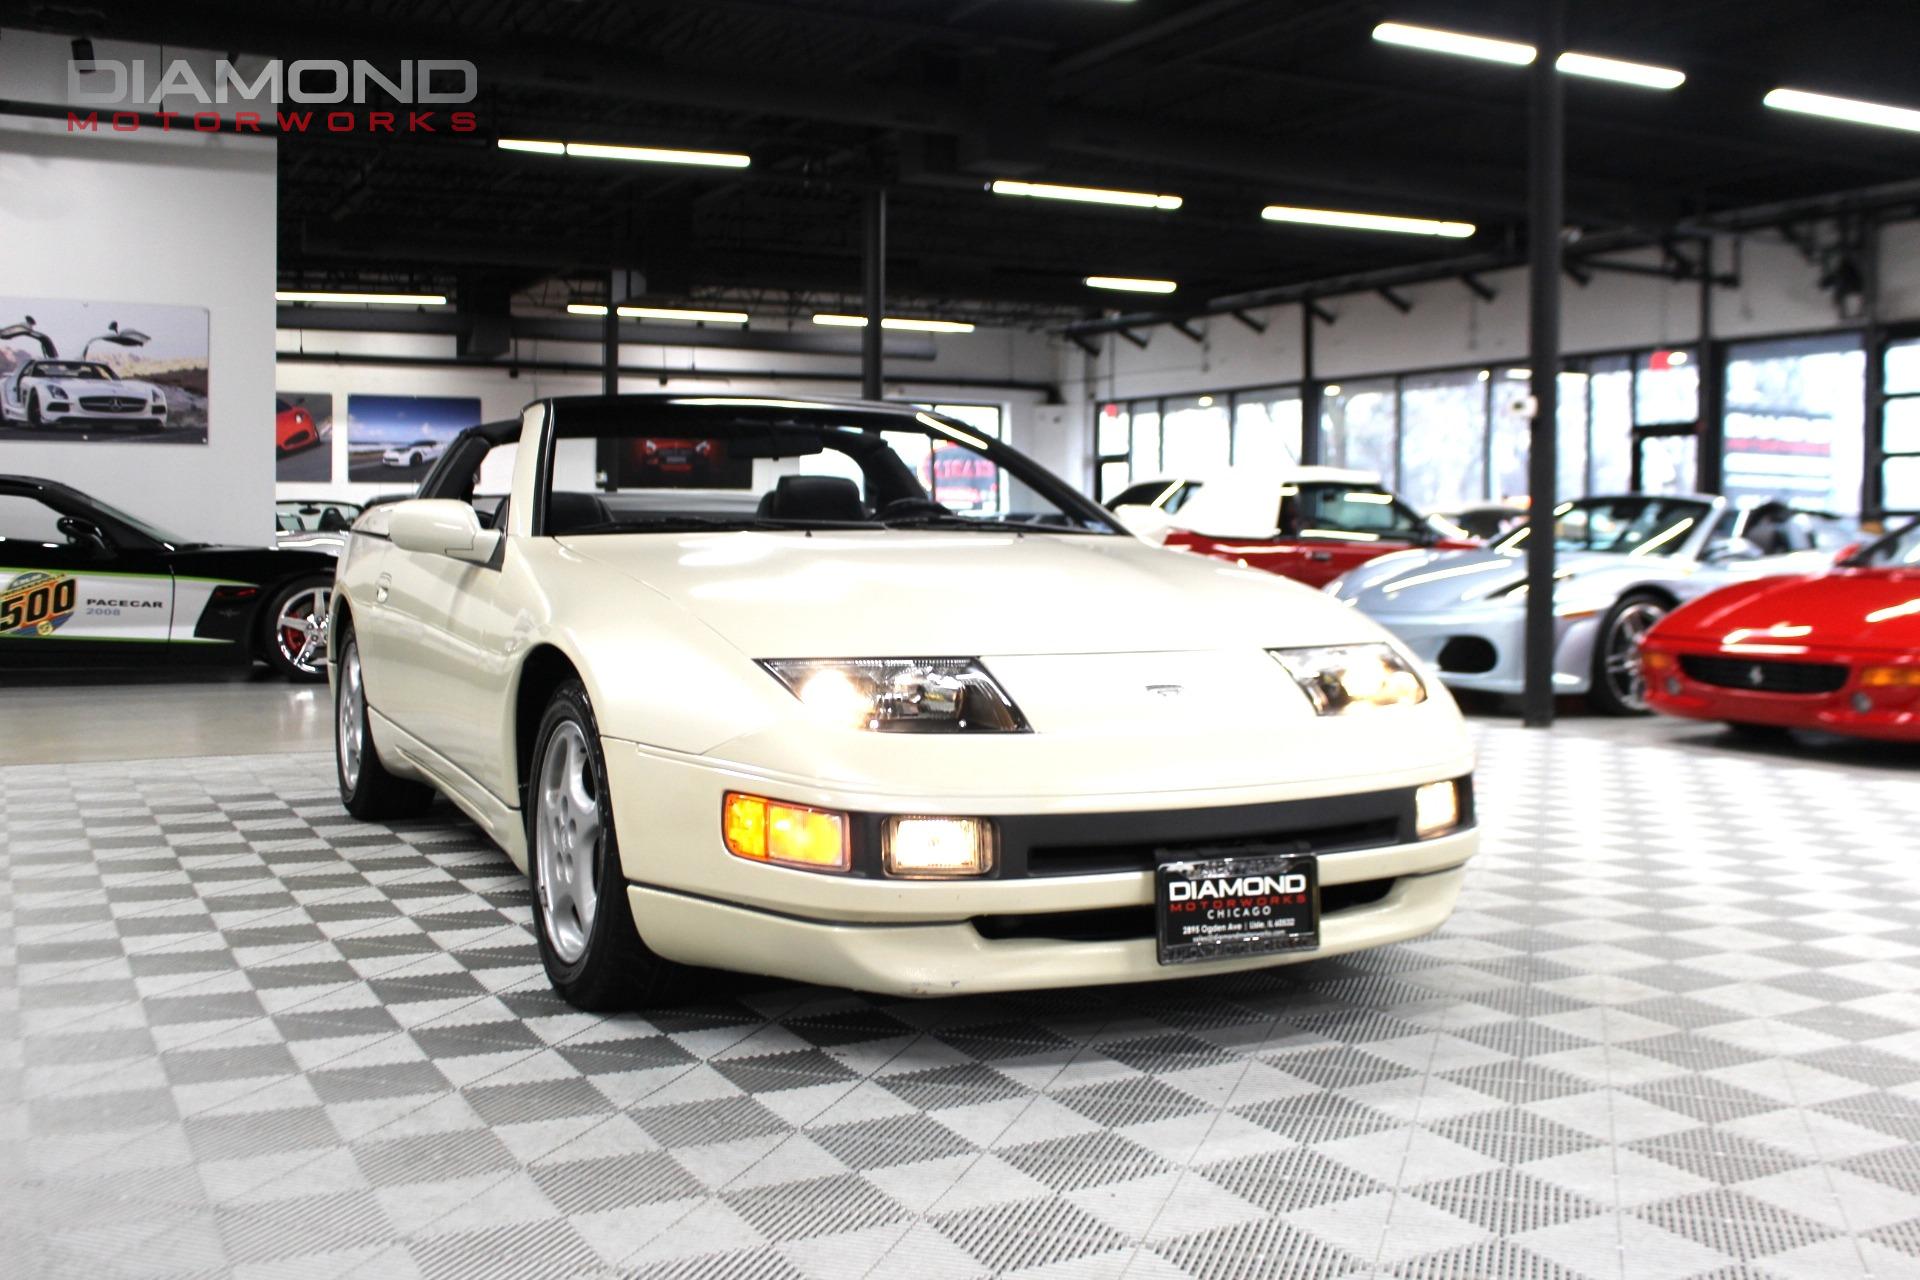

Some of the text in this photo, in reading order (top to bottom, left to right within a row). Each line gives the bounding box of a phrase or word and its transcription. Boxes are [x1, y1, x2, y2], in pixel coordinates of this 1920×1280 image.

[0, 578, 76, 631] 500
[86, 607, 120, 616] 2008
[1169, 874, 1306, 901] DIAMOND
[1169, 894, 1306, 912] MOTORWORKS
[1206, 906, 1272, 920] CHICAGO
